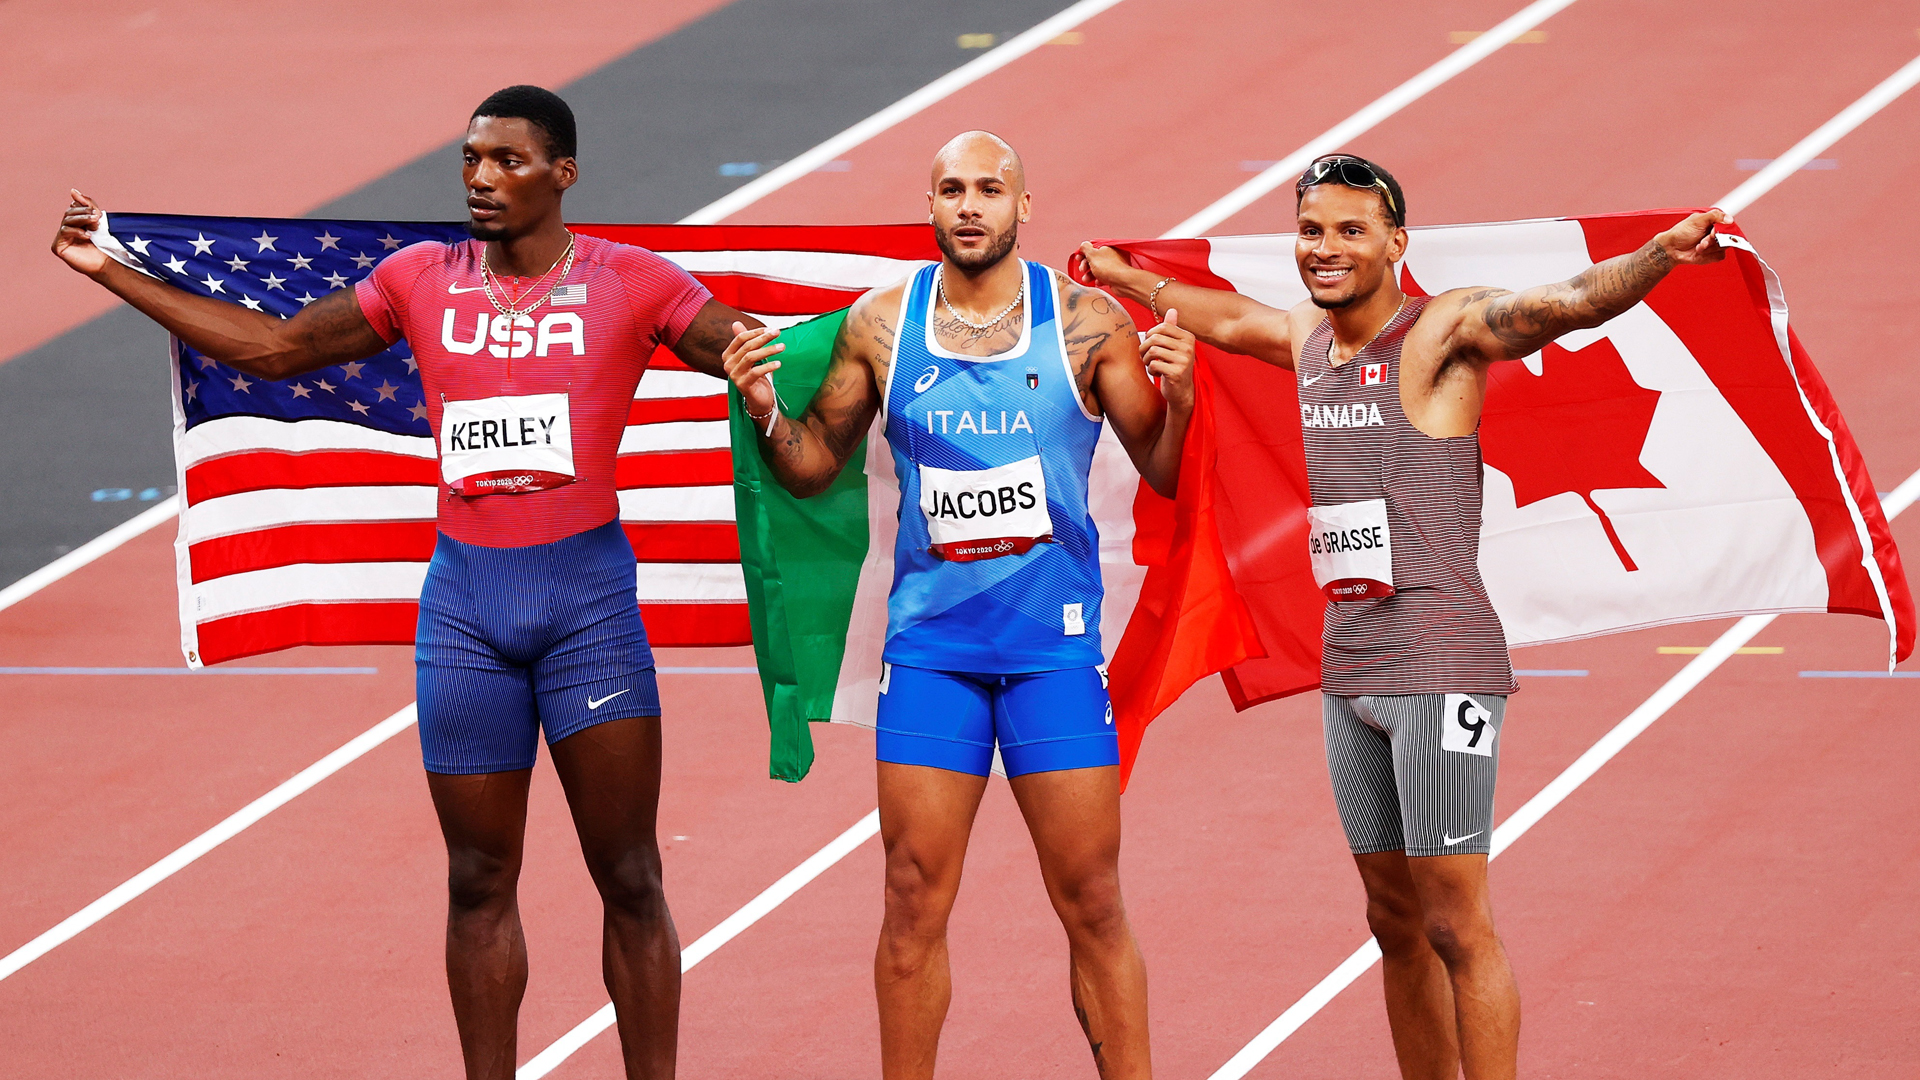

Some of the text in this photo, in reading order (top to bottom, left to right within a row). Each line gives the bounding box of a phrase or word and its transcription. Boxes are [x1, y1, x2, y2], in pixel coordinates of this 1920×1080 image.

[441, 308, 585, 358] USA
[927, 410, 1034, 435] ITALIA
[1302, 403, 1385, 428] CANADA
[451, 416, 556, 452] KERLEY
[496, 478, 513, 486] 2020
[928, 481, 1037, 520] JACOBS
[955, 546, 993, 555] TOKYO 2020
[1310, 526, 1384, 555] de GRASSE
[1457, 700, 1486, 748] 9
